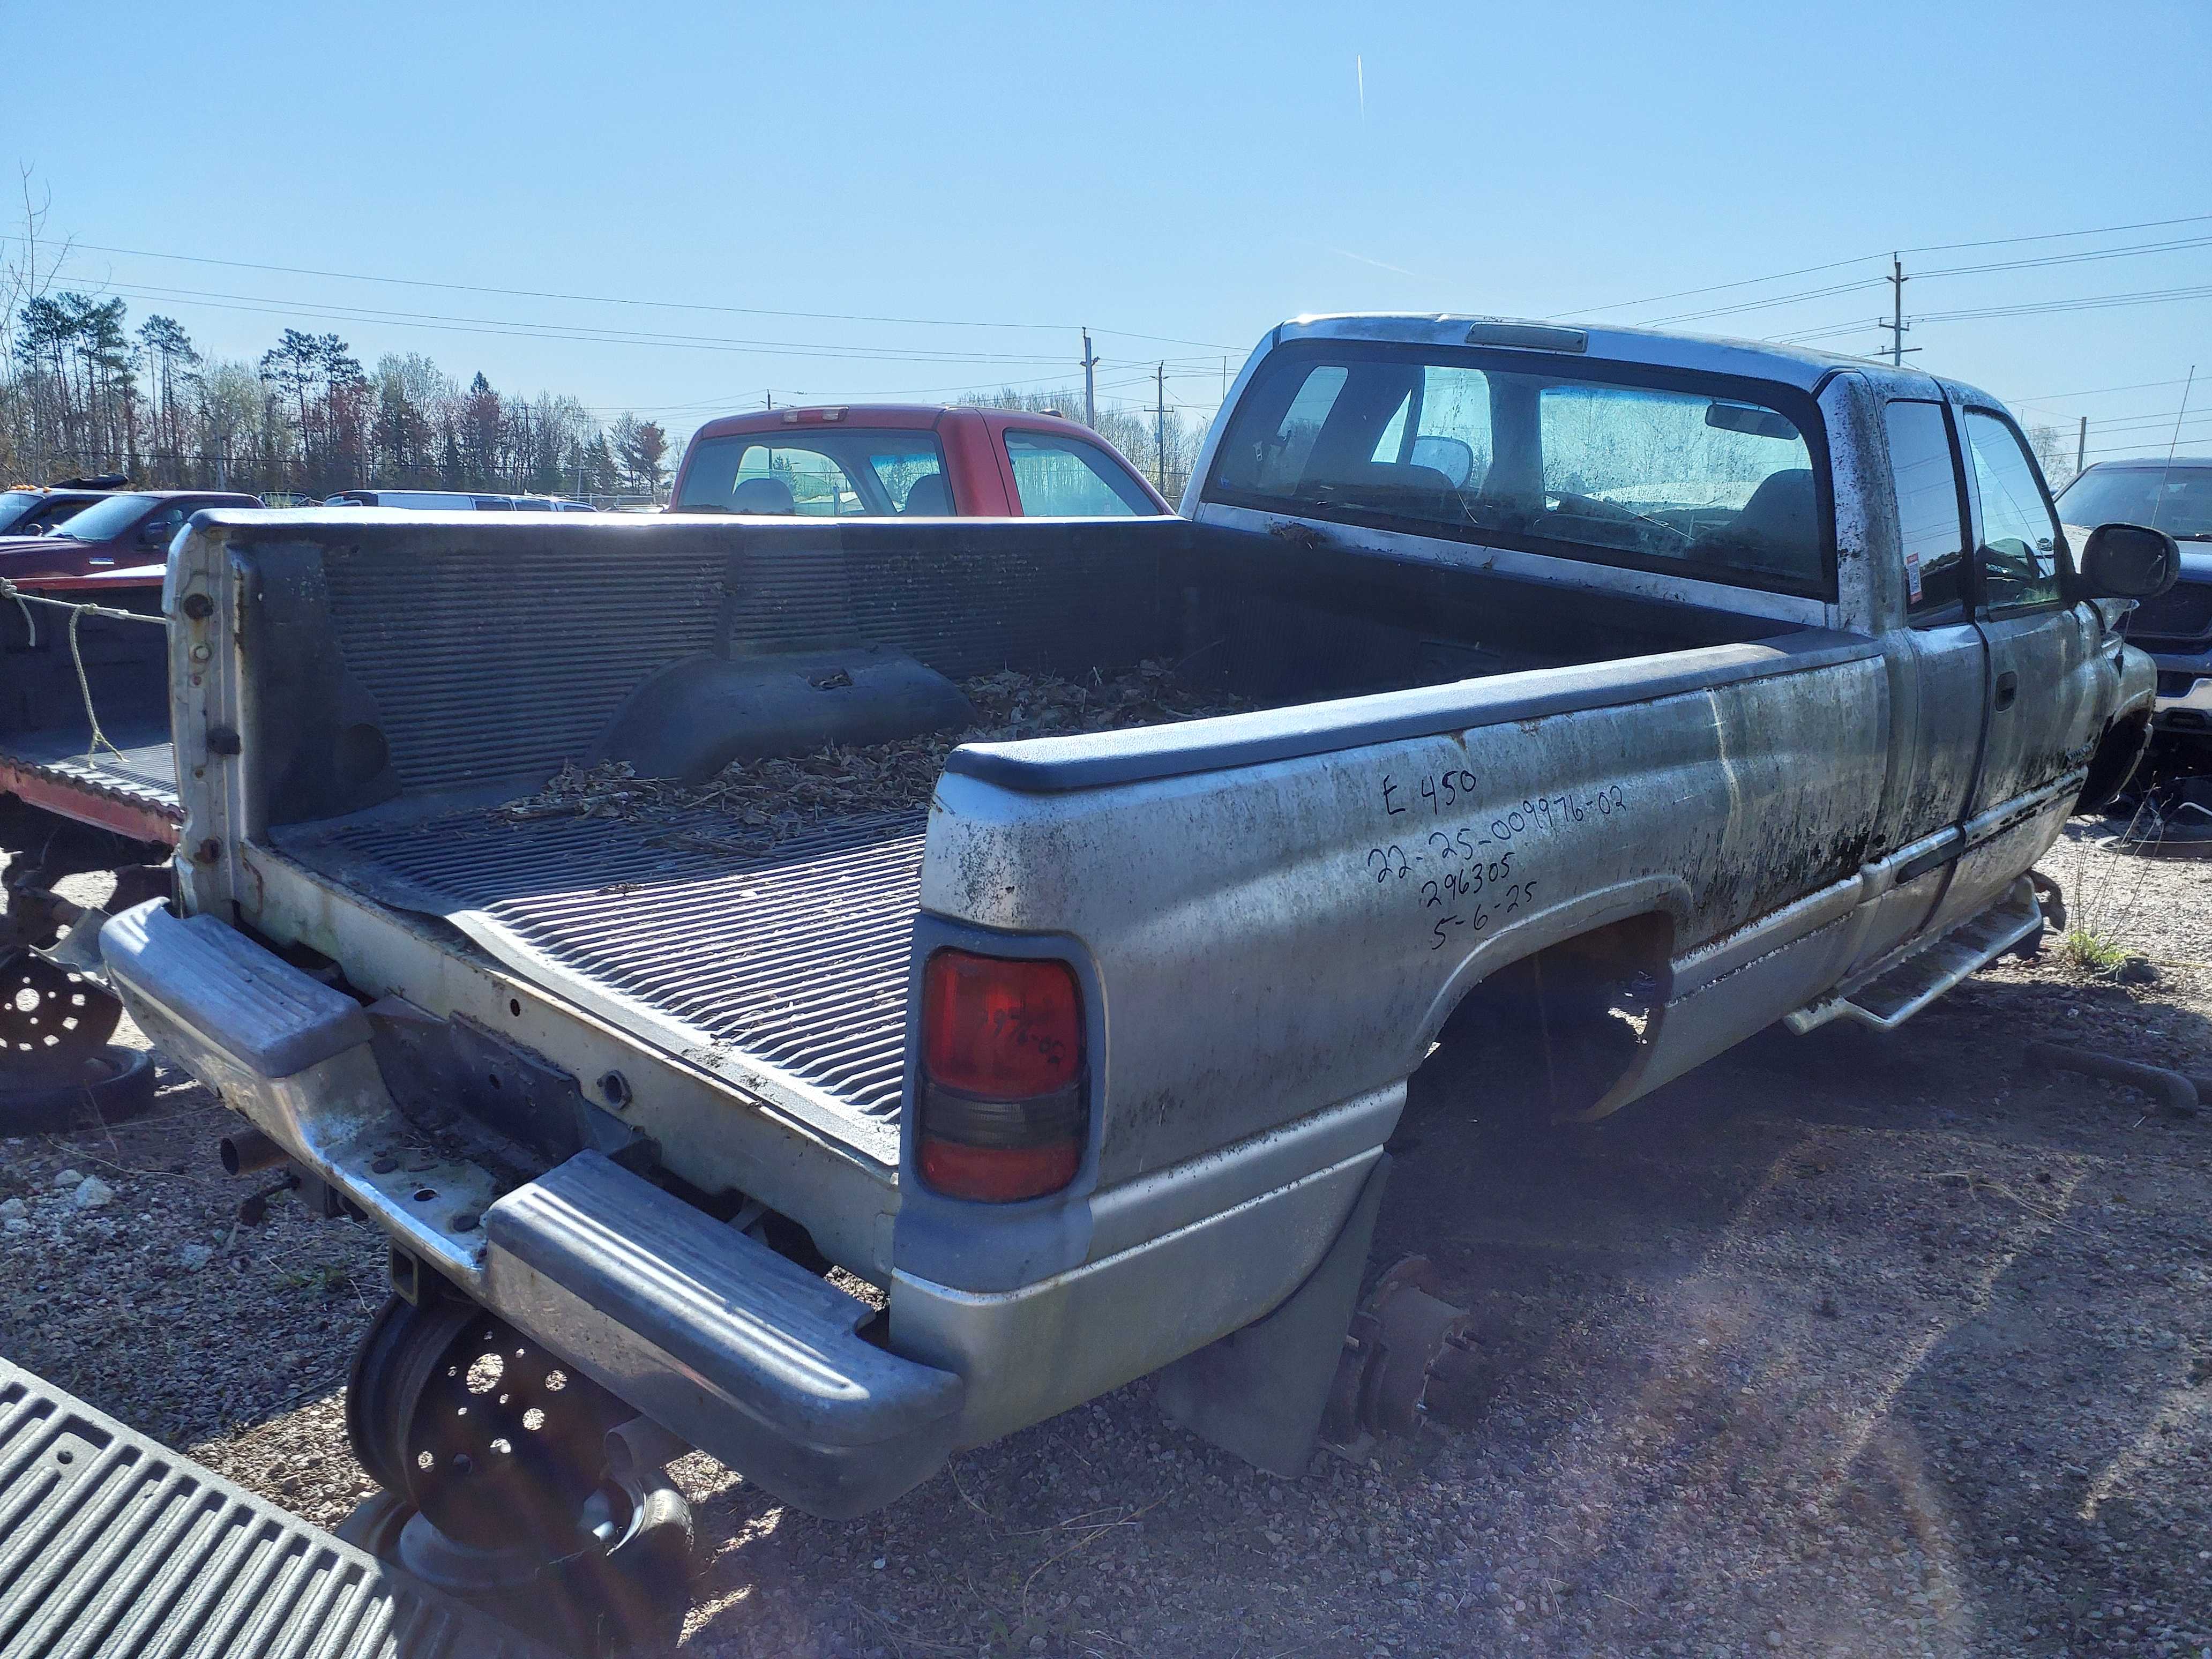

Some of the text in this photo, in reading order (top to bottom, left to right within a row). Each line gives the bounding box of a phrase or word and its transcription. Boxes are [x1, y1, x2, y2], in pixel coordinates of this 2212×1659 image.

[1383, 770, 1476, 815] E 450
[1367, 785, 1626, 883] 22-25-009976-02
[1421, 852, 1515, 907] 296305
[1431, 880, 1537, 951] 5-6-25
